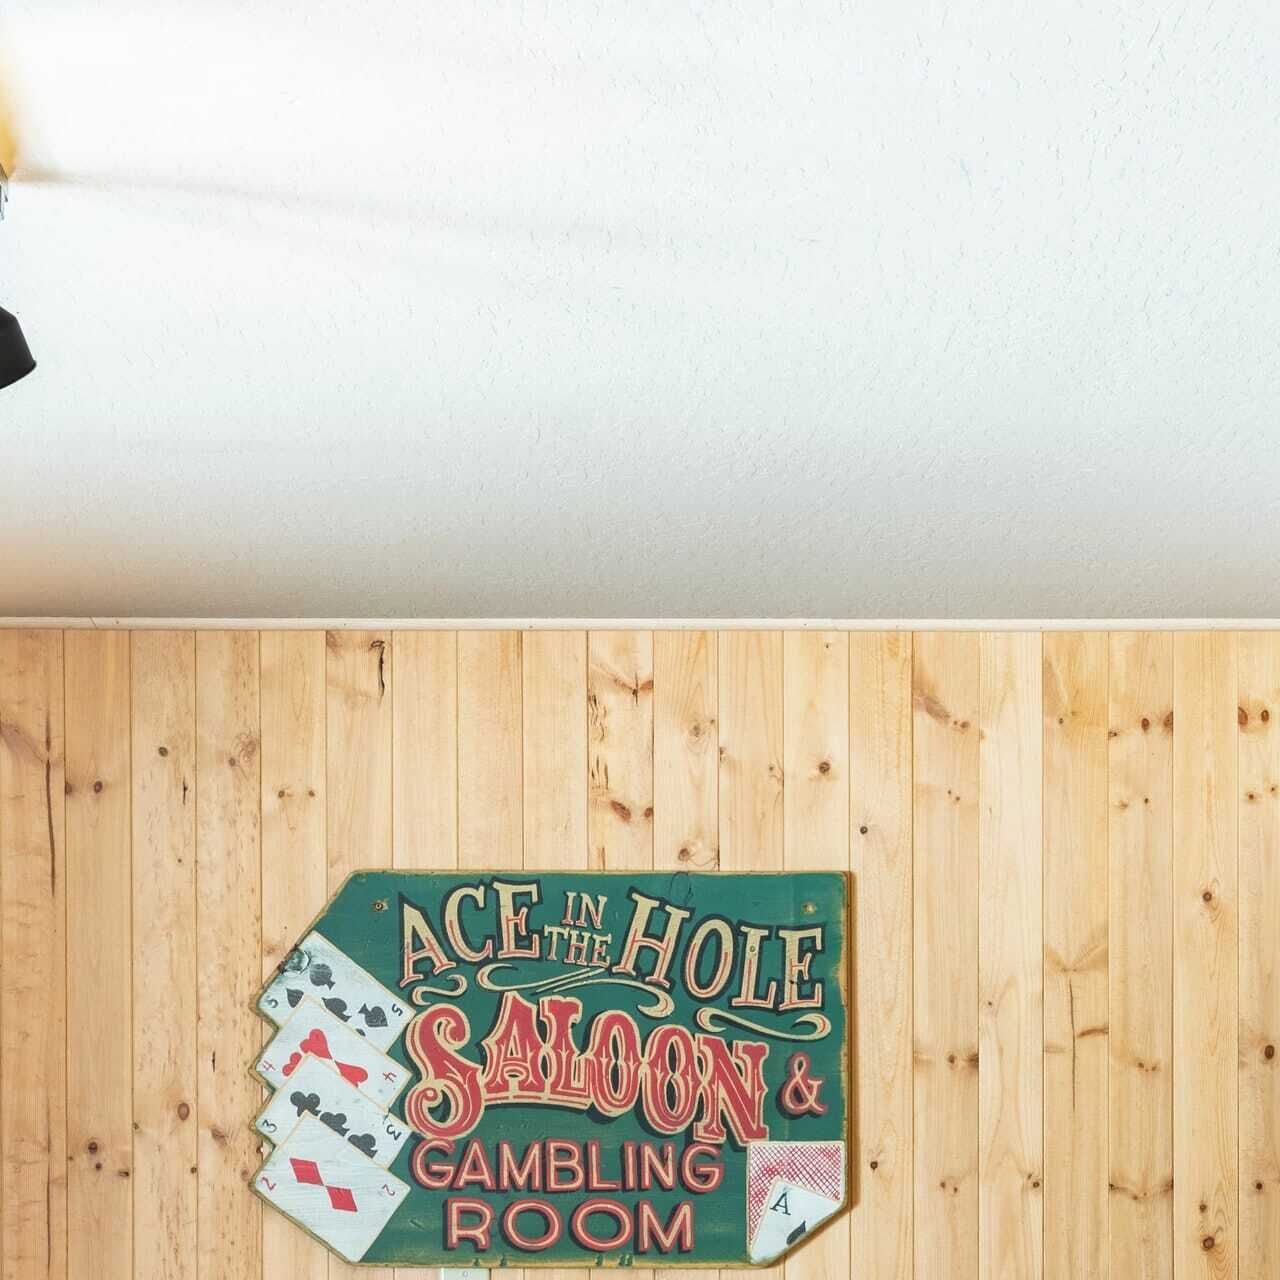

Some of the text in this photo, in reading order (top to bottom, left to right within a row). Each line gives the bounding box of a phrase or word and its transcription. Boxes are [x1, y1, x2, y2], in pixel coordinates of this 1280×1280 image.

[400, 878, 823, 1012] ACE IN THE HOLE
[405, 990, 827, 1147] SALOON &
[412, 1138, 725, 1193] GAMBLING
[446, 1198, 694, 1254] ROOM
[769, 1191, 791, 1216] A
